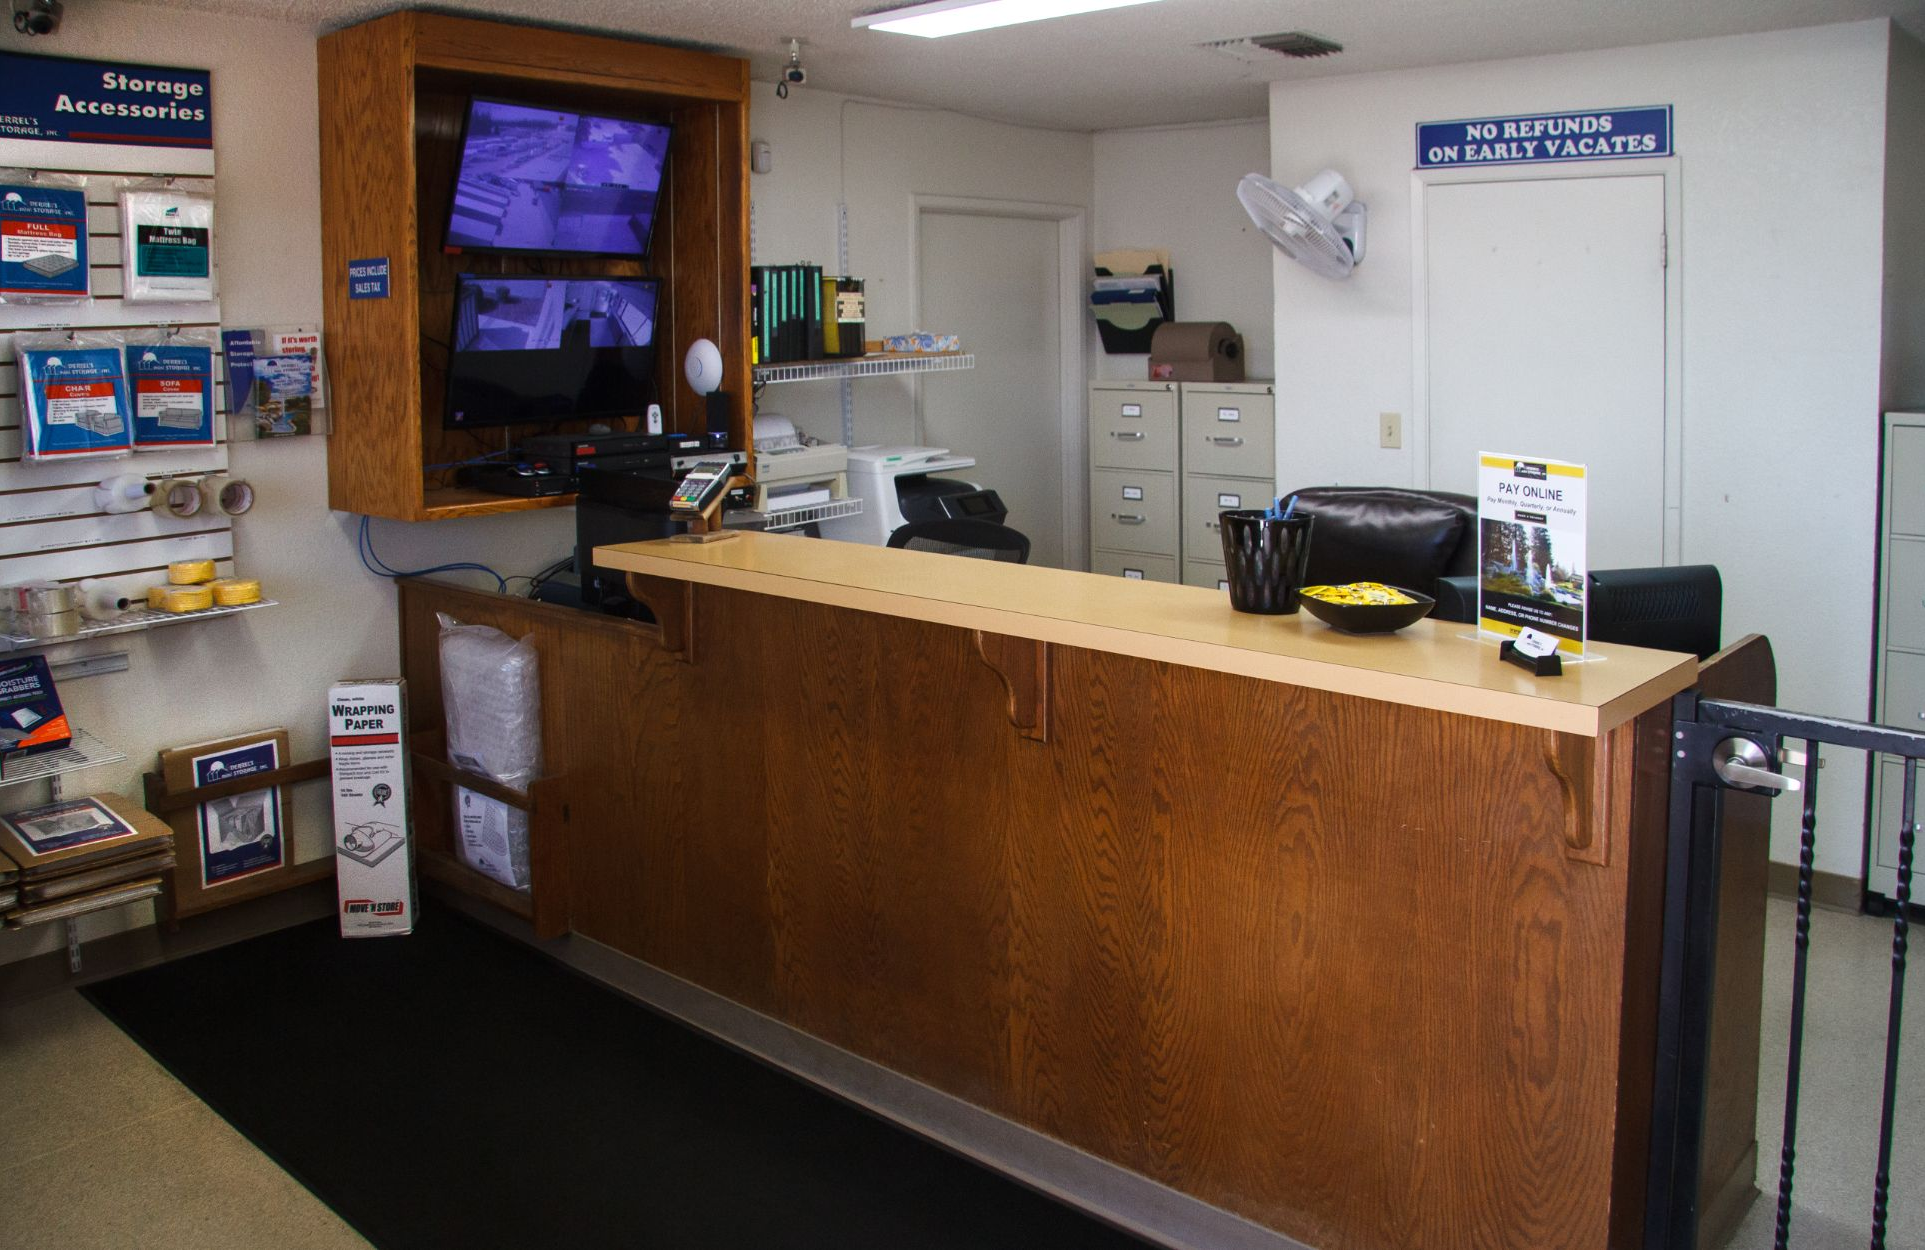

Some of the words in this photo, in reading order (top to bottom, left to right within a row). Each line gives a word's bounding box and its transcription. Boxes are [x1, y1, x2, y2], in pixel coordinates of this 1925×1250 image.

[103, 72, 204, 100] Storage
[55, 94, 205, 121] Accessories
[0, 115, 38, 126] ERREL'S
[0, 125, 43, 137] TORAGE,
[1465, 124, 1498, 141] NO
[1503, 115, 1613, 139] REFUNDS
[1428, 145, 1459, 163] ON
[1464, 141, 1539, 160] EARLY
[1544, 134, 1657, 158] VACATES
[27, 223, 50, 231] FULL
[164, 227, 182, 236] Twin
[149, 235, 182, 244] Mattress
[182, 236, 197, 245] Bag
[349, 267, 367, 278] PRICES
[367, 264, 387, 276] INCLUDE
[355, 283, 370, 294] SALES
[371, 281, 381, 292] TAX
[299, 335, 318, 343] worth
[1498, 482, 1520, 495] PAY
[1523, 485, 1563, 502] ONLINE
[1553, 504, 1577, 516] Annually
[1485, 604, 1498, 612] NAME,
[1498, 607, 1517, 618] ADDRESS,
[1525, 614, 1540, 622] PHONE
[1540, 617, 1558, 626] NUMBER
[1558, 622, 1579, 632] CHANGES
[0, 675, 39, 688] OISTURE
[331, 704, 395, 717] WRAPPING
[344, 718, 384, 731] PAPER
[349, 903, 369, 914] MOVE
[377, 902, 400, 912] STORE
